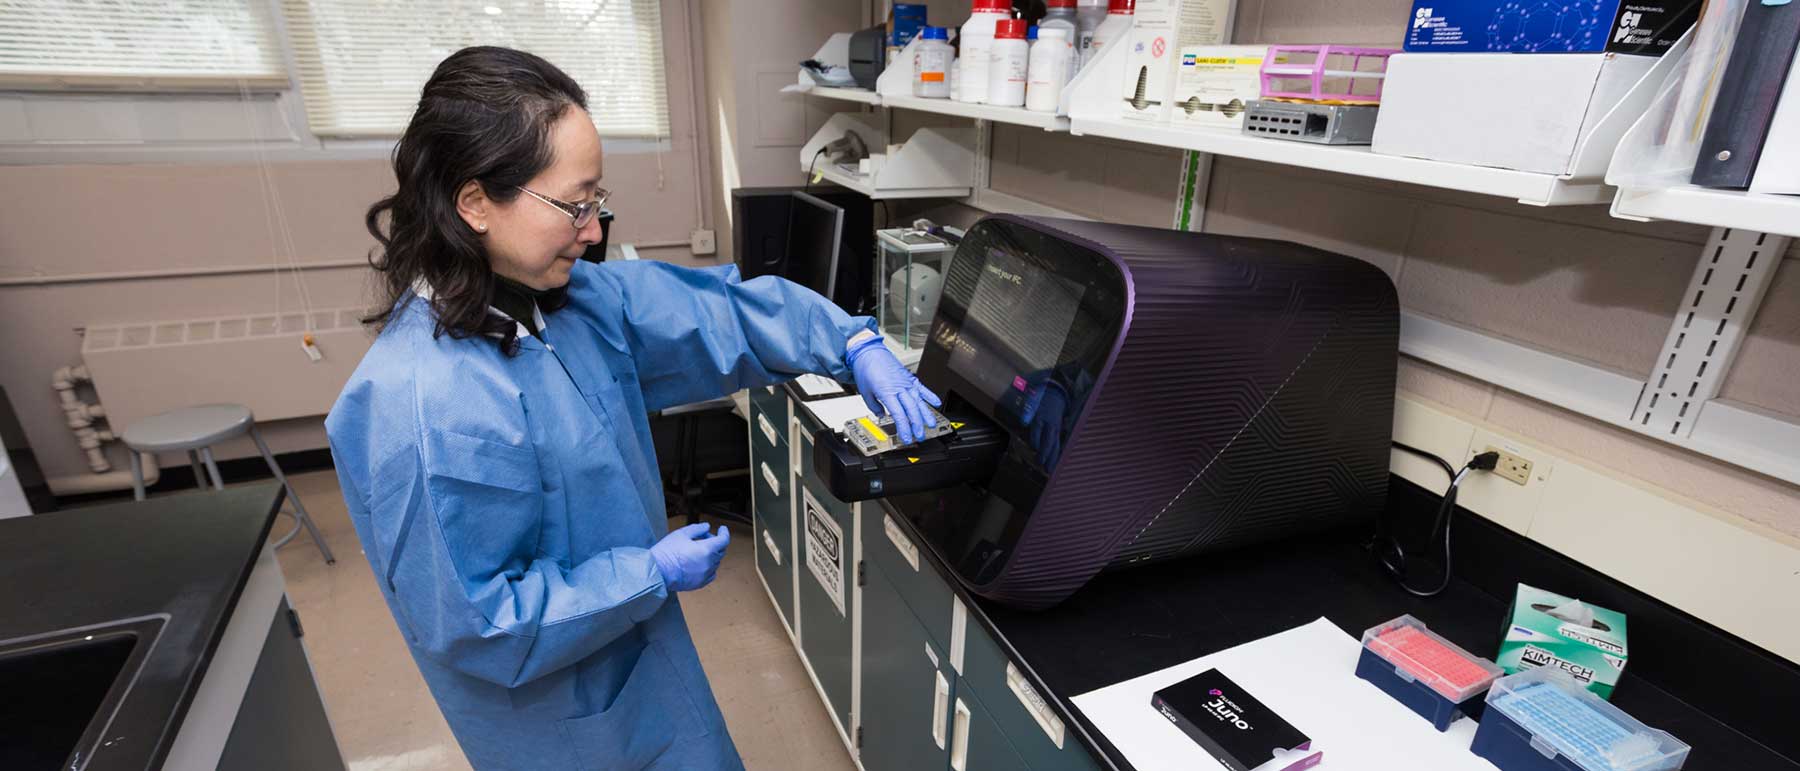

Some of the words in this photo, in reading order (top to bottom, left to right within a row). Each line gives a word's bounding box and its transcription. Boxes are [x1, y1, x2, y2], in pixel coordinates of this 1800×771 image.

[810, 513, 836, 557] DANGER
[1523, 649, 1594, 678] KIMTECH
[1161, 706, 1177, 723] Juno
